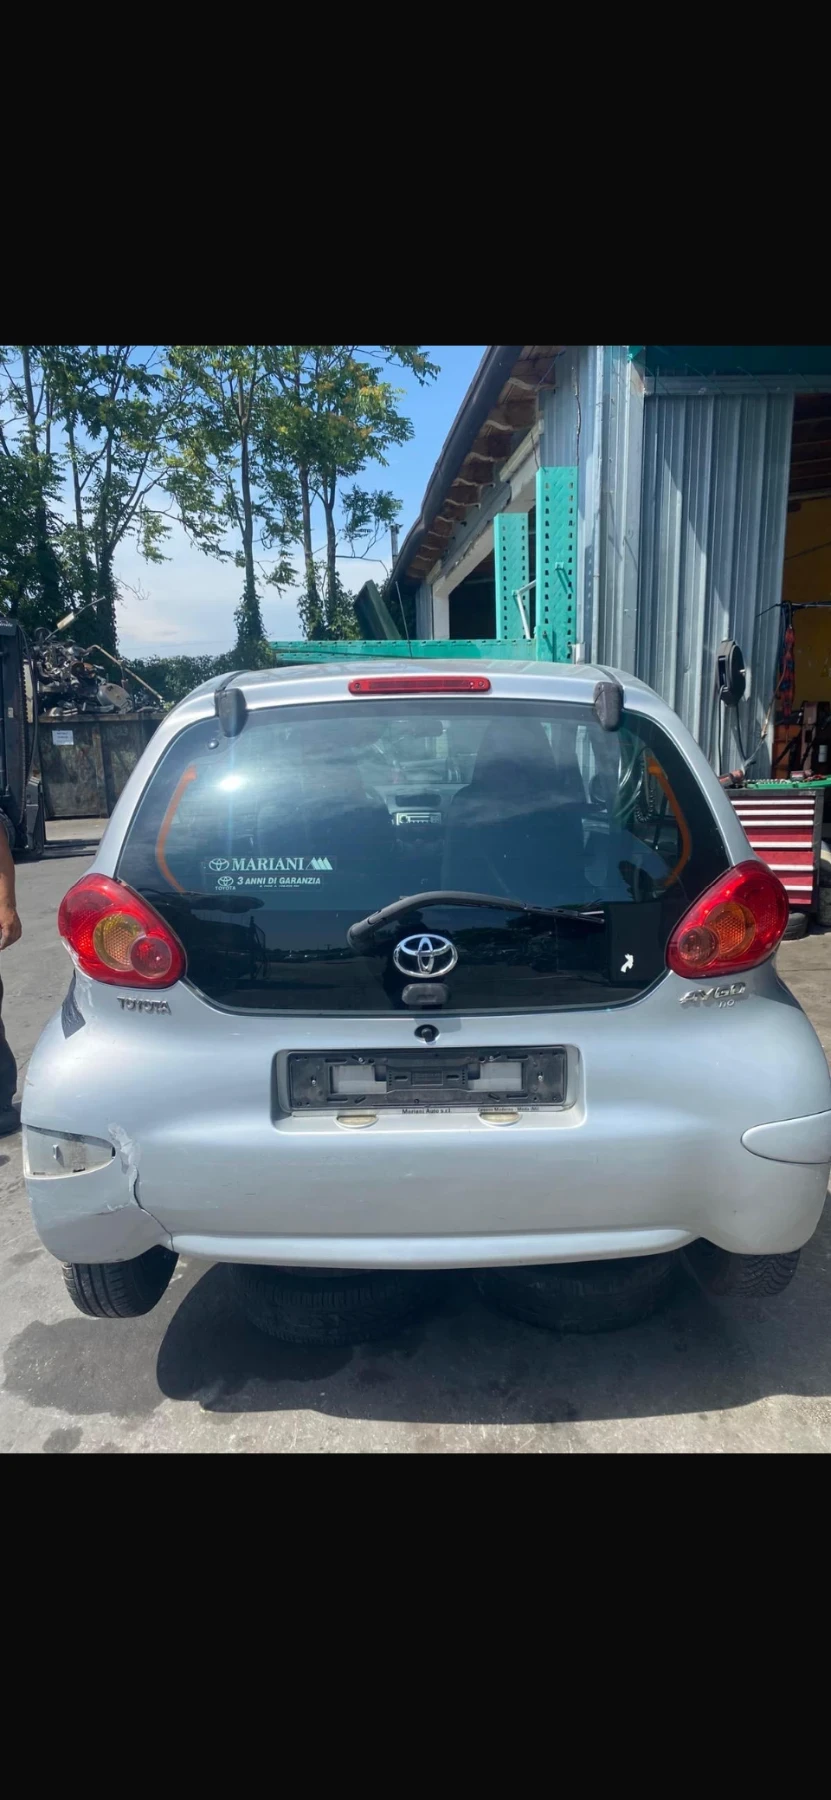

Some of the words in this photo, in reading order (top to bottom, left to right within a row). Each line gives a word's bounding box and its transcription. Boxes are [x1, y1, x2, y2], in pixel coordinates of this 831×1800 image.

[231, 857, 305, 871] MARIANI
[237, 876, 244, 885] 3
[245, 877, 266, 885] ANNI
[268, 877, 277, 885] DI
[279, 877, 321, 885] GARANZIA
[117, 996, 172, 1016] TOYOTA
